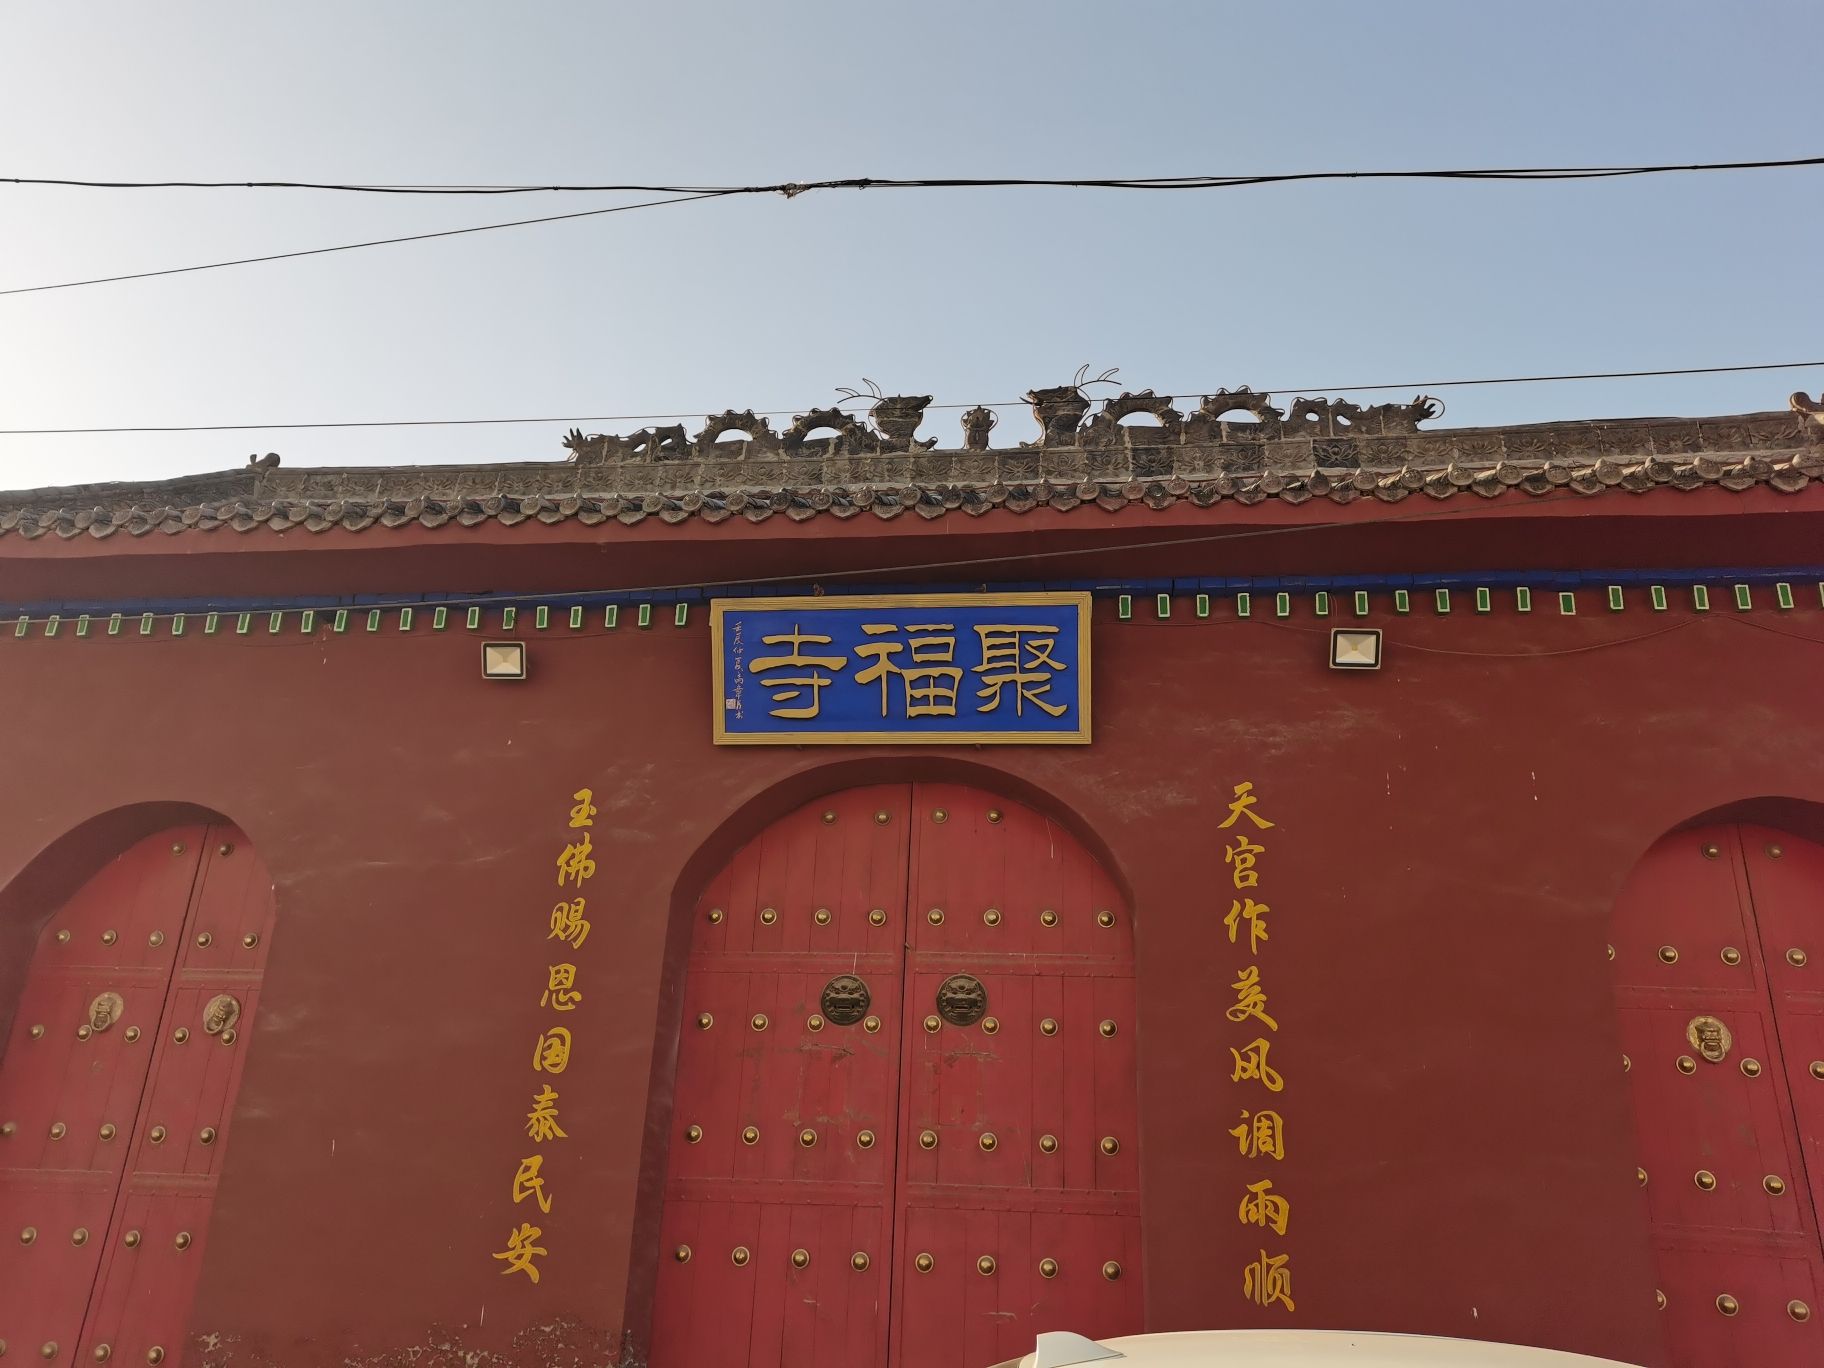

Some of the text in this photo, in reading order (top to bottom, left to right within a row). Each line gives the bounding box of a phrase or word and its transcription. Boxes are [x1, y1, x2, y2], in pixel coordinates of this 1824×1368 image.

[748, 624, 1067, 719] 聚福寺
[492, 787, 598, 1283] 玉佛赐恩国泰民安
[1217, 782, 1296, 1312] 天宫作美风调雨顺
